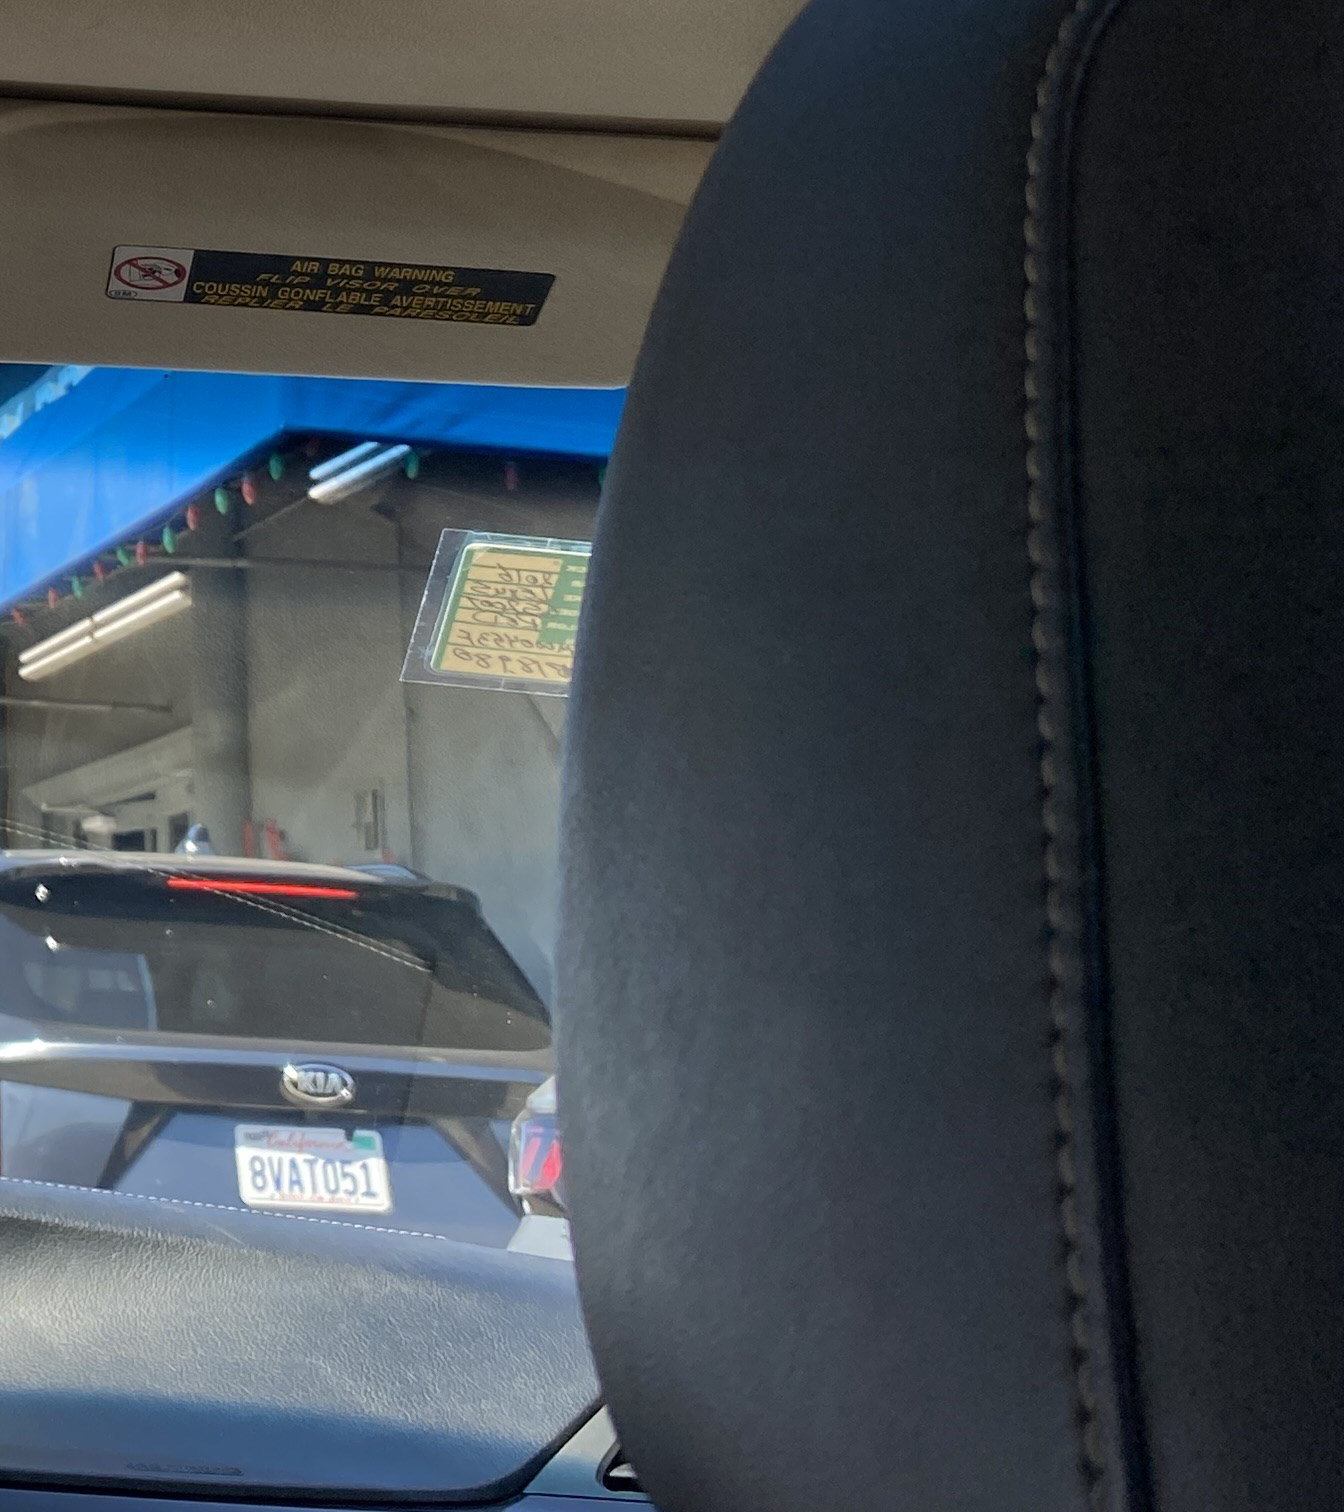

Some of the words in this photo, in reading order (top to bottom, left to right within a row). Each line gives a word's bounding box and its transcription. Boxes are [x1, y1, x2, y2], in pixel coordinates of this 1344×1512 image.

[255, 272, 310, 285] FLIP
[324, 277, 400, 292] VISOR
[411, 284, 482, 297] OVER
[289, 260, 321, 275] AIR
[327, 262, 366, 278] BAG
[374, 264, 457, 283] WARNING
[192, 280, 268, 297] COUSSIN
[278, 286, 382, 306] GONFLABLE
[391, 292, 536, 316] AVERTISSEMENT
[199, 294, 303, 310] REPLIER
[323, 300, 352, 314] LE
[369, 303, 520, 325] PARESOLEIL
[296, 1071, 343, 1094] KIA
[249, 1156, 378, 1197] 8VAT051
